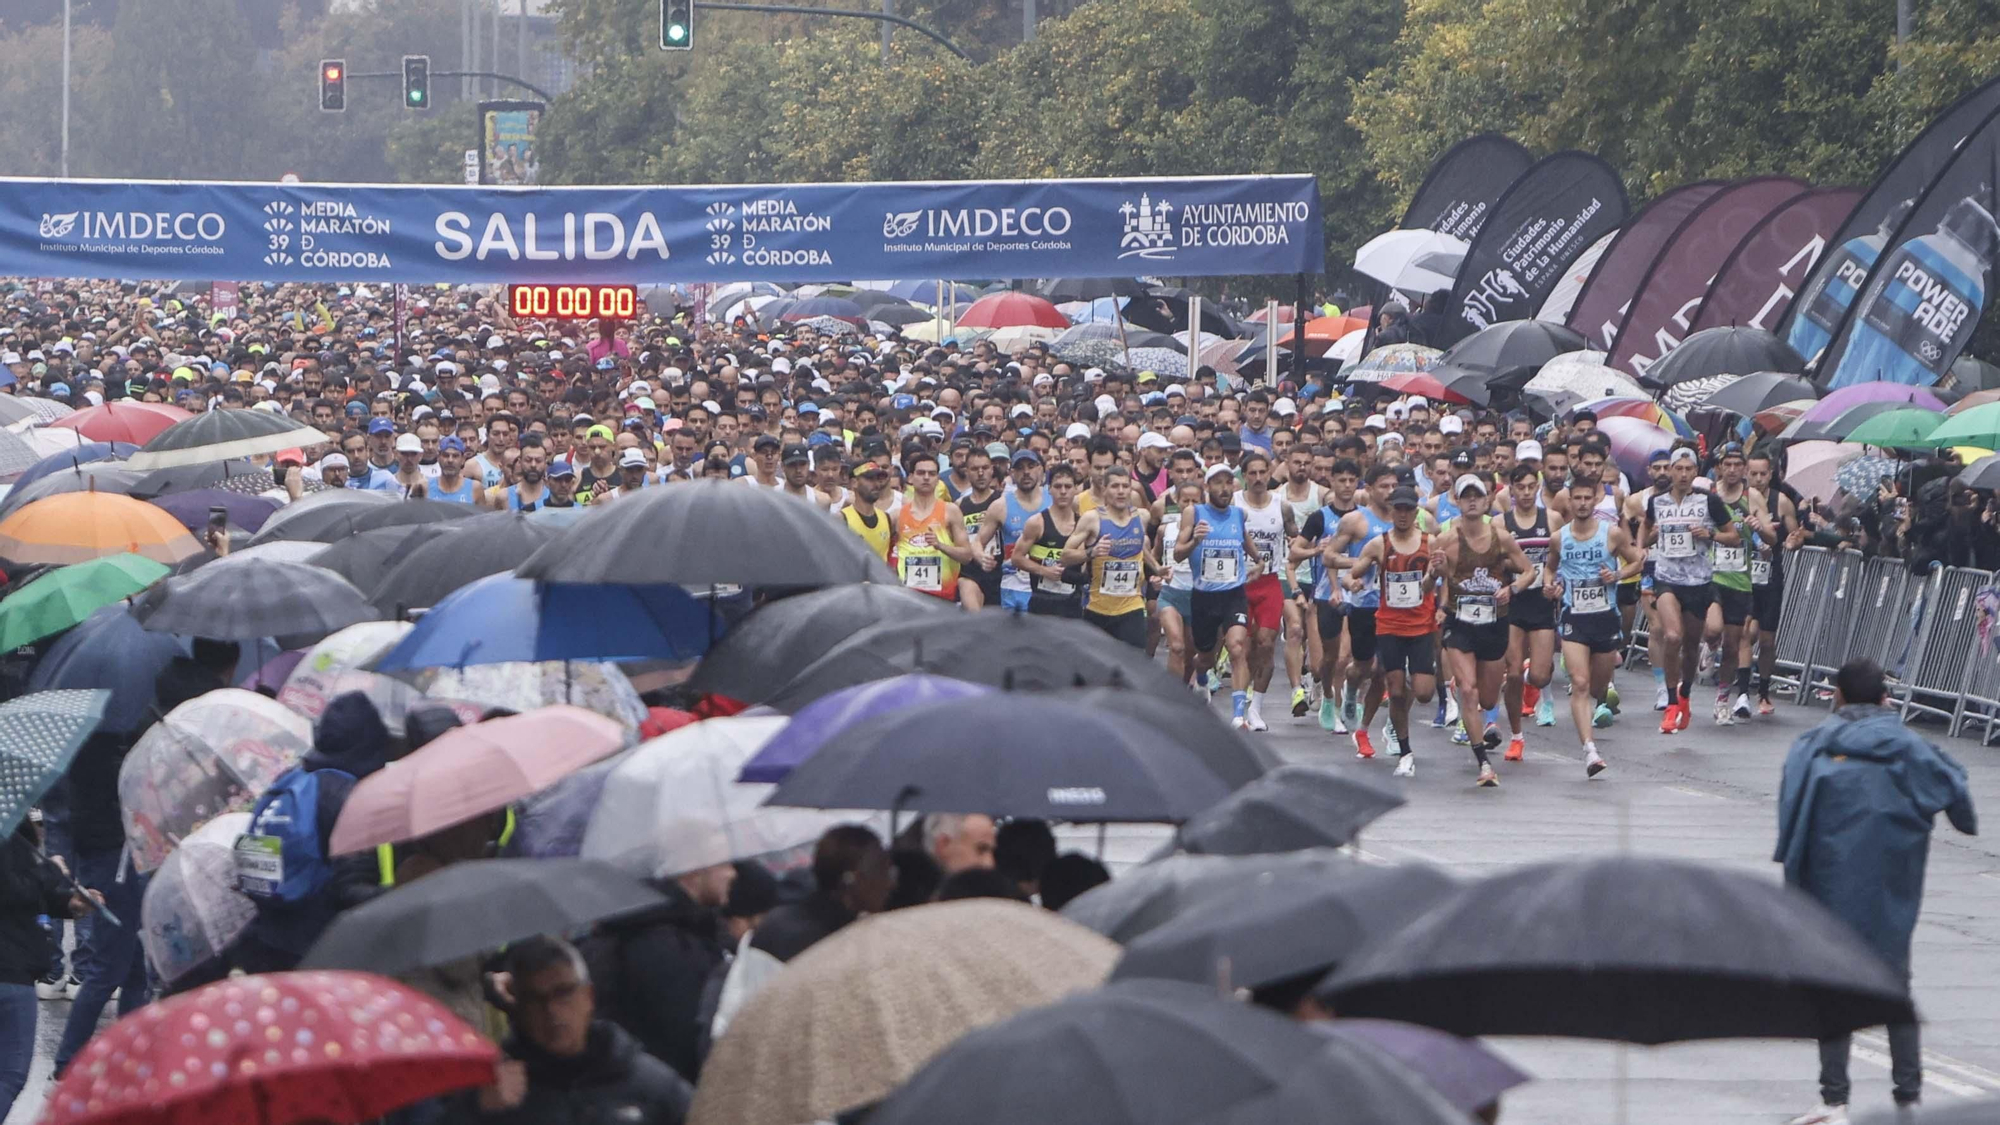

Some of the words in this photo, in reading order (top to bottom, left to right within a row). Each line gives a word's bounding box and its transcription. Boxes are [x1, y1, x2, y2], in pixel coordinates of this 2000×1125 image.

[301, 201, 357, 217] MEDIA
[742, 199, 798, 216] MEDIA
[1181, 201, 1309, 225] AYUNTAMIENTO
[83, 211, 226, 241] IMDECO
[300, 215, 391, 235] MARATÓN
[742, 212, 831, 232] MARATÓN
[927, 206, 1072, 237] IMDECO
[268, 233, 290, 250] 39
[434, 211, 670, 261] SALIDA
[710, 233, 731, 250] 39
[1181, 226, 1203, 247] DE
[1206, 222, 1290, 247] CÓRDOBA
[1503, 217, 1547, 263] Ciudades
[1525, 266, 1540, 282] de
[1536, 255, 1550, 268] la
[1547, 197, 1602, 256] Humanidad
[40, 242, 78, 252] Instituto
[79, 243, 125, 254] Municipal
[126, 244, 139, 254] de
[141, 244, 184, 255] Deportes
[185, 244, 225, 255] Córdoba
[883, 243, 923, 253] Instituto
[924, 241, 970, 253] Municipal
[971, 241, 985, 251] de
[986, 240, 1030, 253] Deportes
[1031, 240, 1072, 251] Córdoba
[1513, 217, 1565, 273] Patrimonio
[1559, 235, 1585, 262] UNESCO
[300, 248, 392, 268] CÓRDOBA
[742, 246, 833, 266] CÓRDOBA
[515, 286, 550, 315] 00
[557, 286, 591, 315] 00
[598, 287, 633, 316] 00
[1894, 259, 1969, 327] POWER
[1912, 301, 1959, 344] ADE
[1658, 507, 1705, 519] KAILAS
[1670, 534, 1685, 545] 63
[1565, 546, 1603, 561] nerja
[1724, 549, 1737, 560] 31
[914, 567, 929, 578] 41
[1216, 560, 1224, 571] 8
[1113, 572, 1128, 583] 44
[1399, 584, 1407, 595] 3
[1574, 588, 1604, 601] 7664
[1472, 607, 1481, 618] 4
